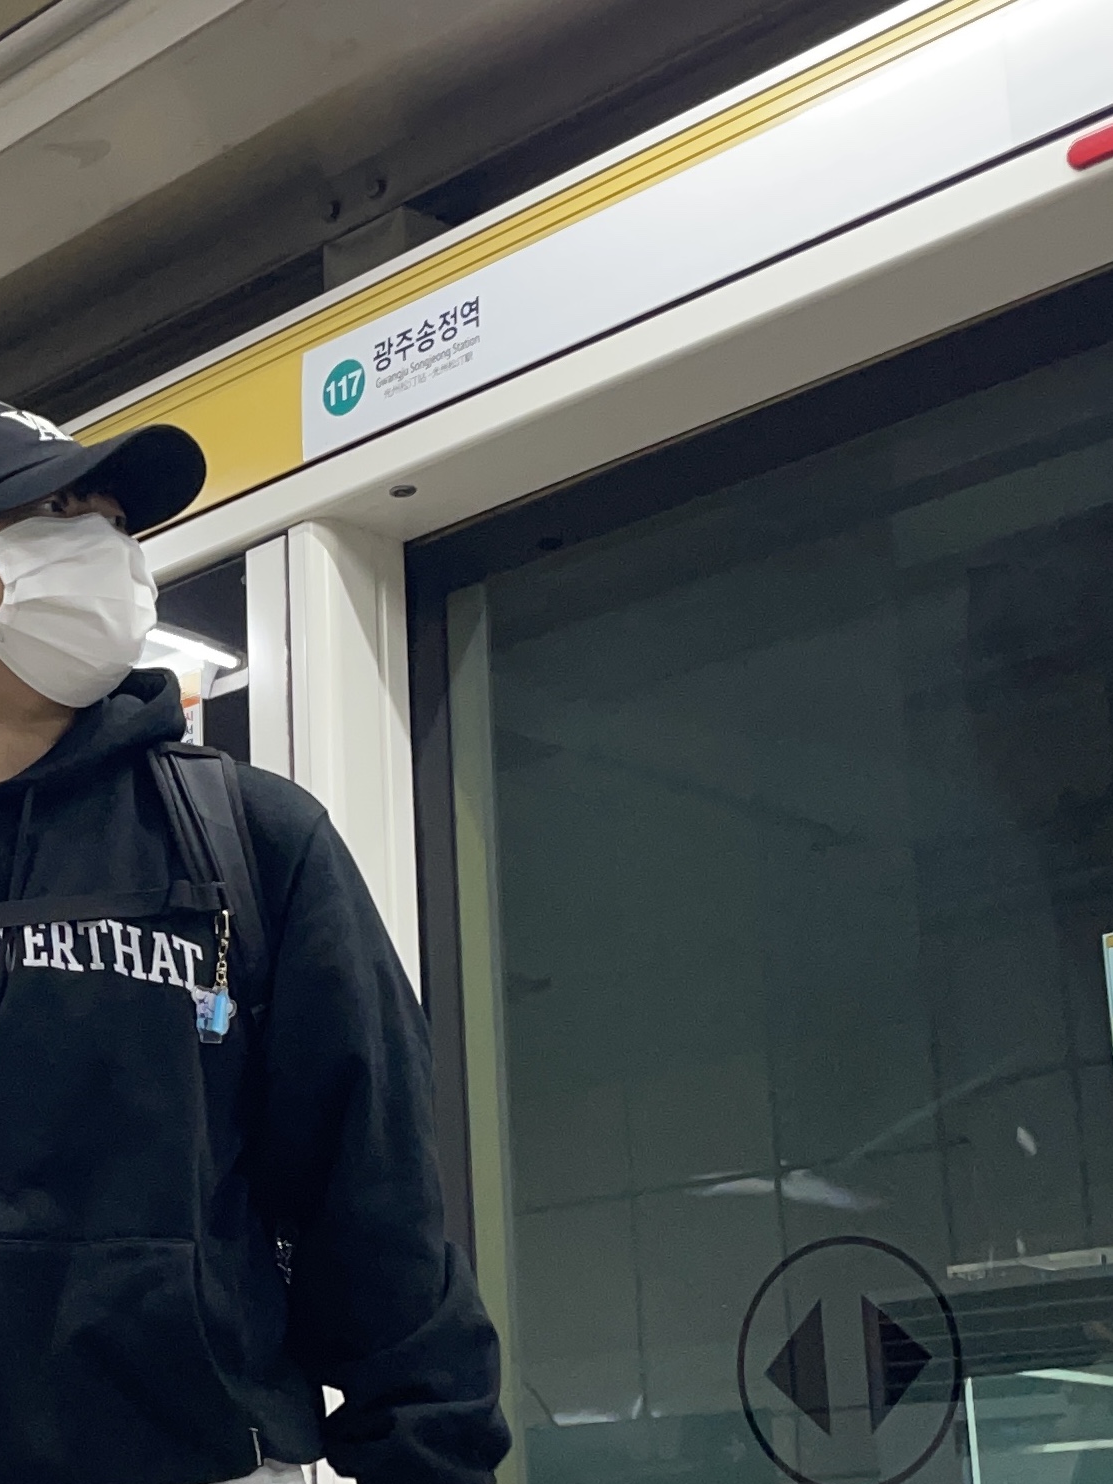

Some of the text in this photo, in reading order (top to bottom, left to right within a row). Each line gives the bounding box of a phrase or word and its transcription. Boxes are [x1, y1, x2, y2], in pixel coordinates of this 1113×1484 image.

[373, 295, 480, 372] 광주송정역
[326, 368, 363, 407] 117
[375, 367, 409, 389] Gwangju
[409, 348, 452, 375] Songjeong
[452, 335, 481, 355] Station
